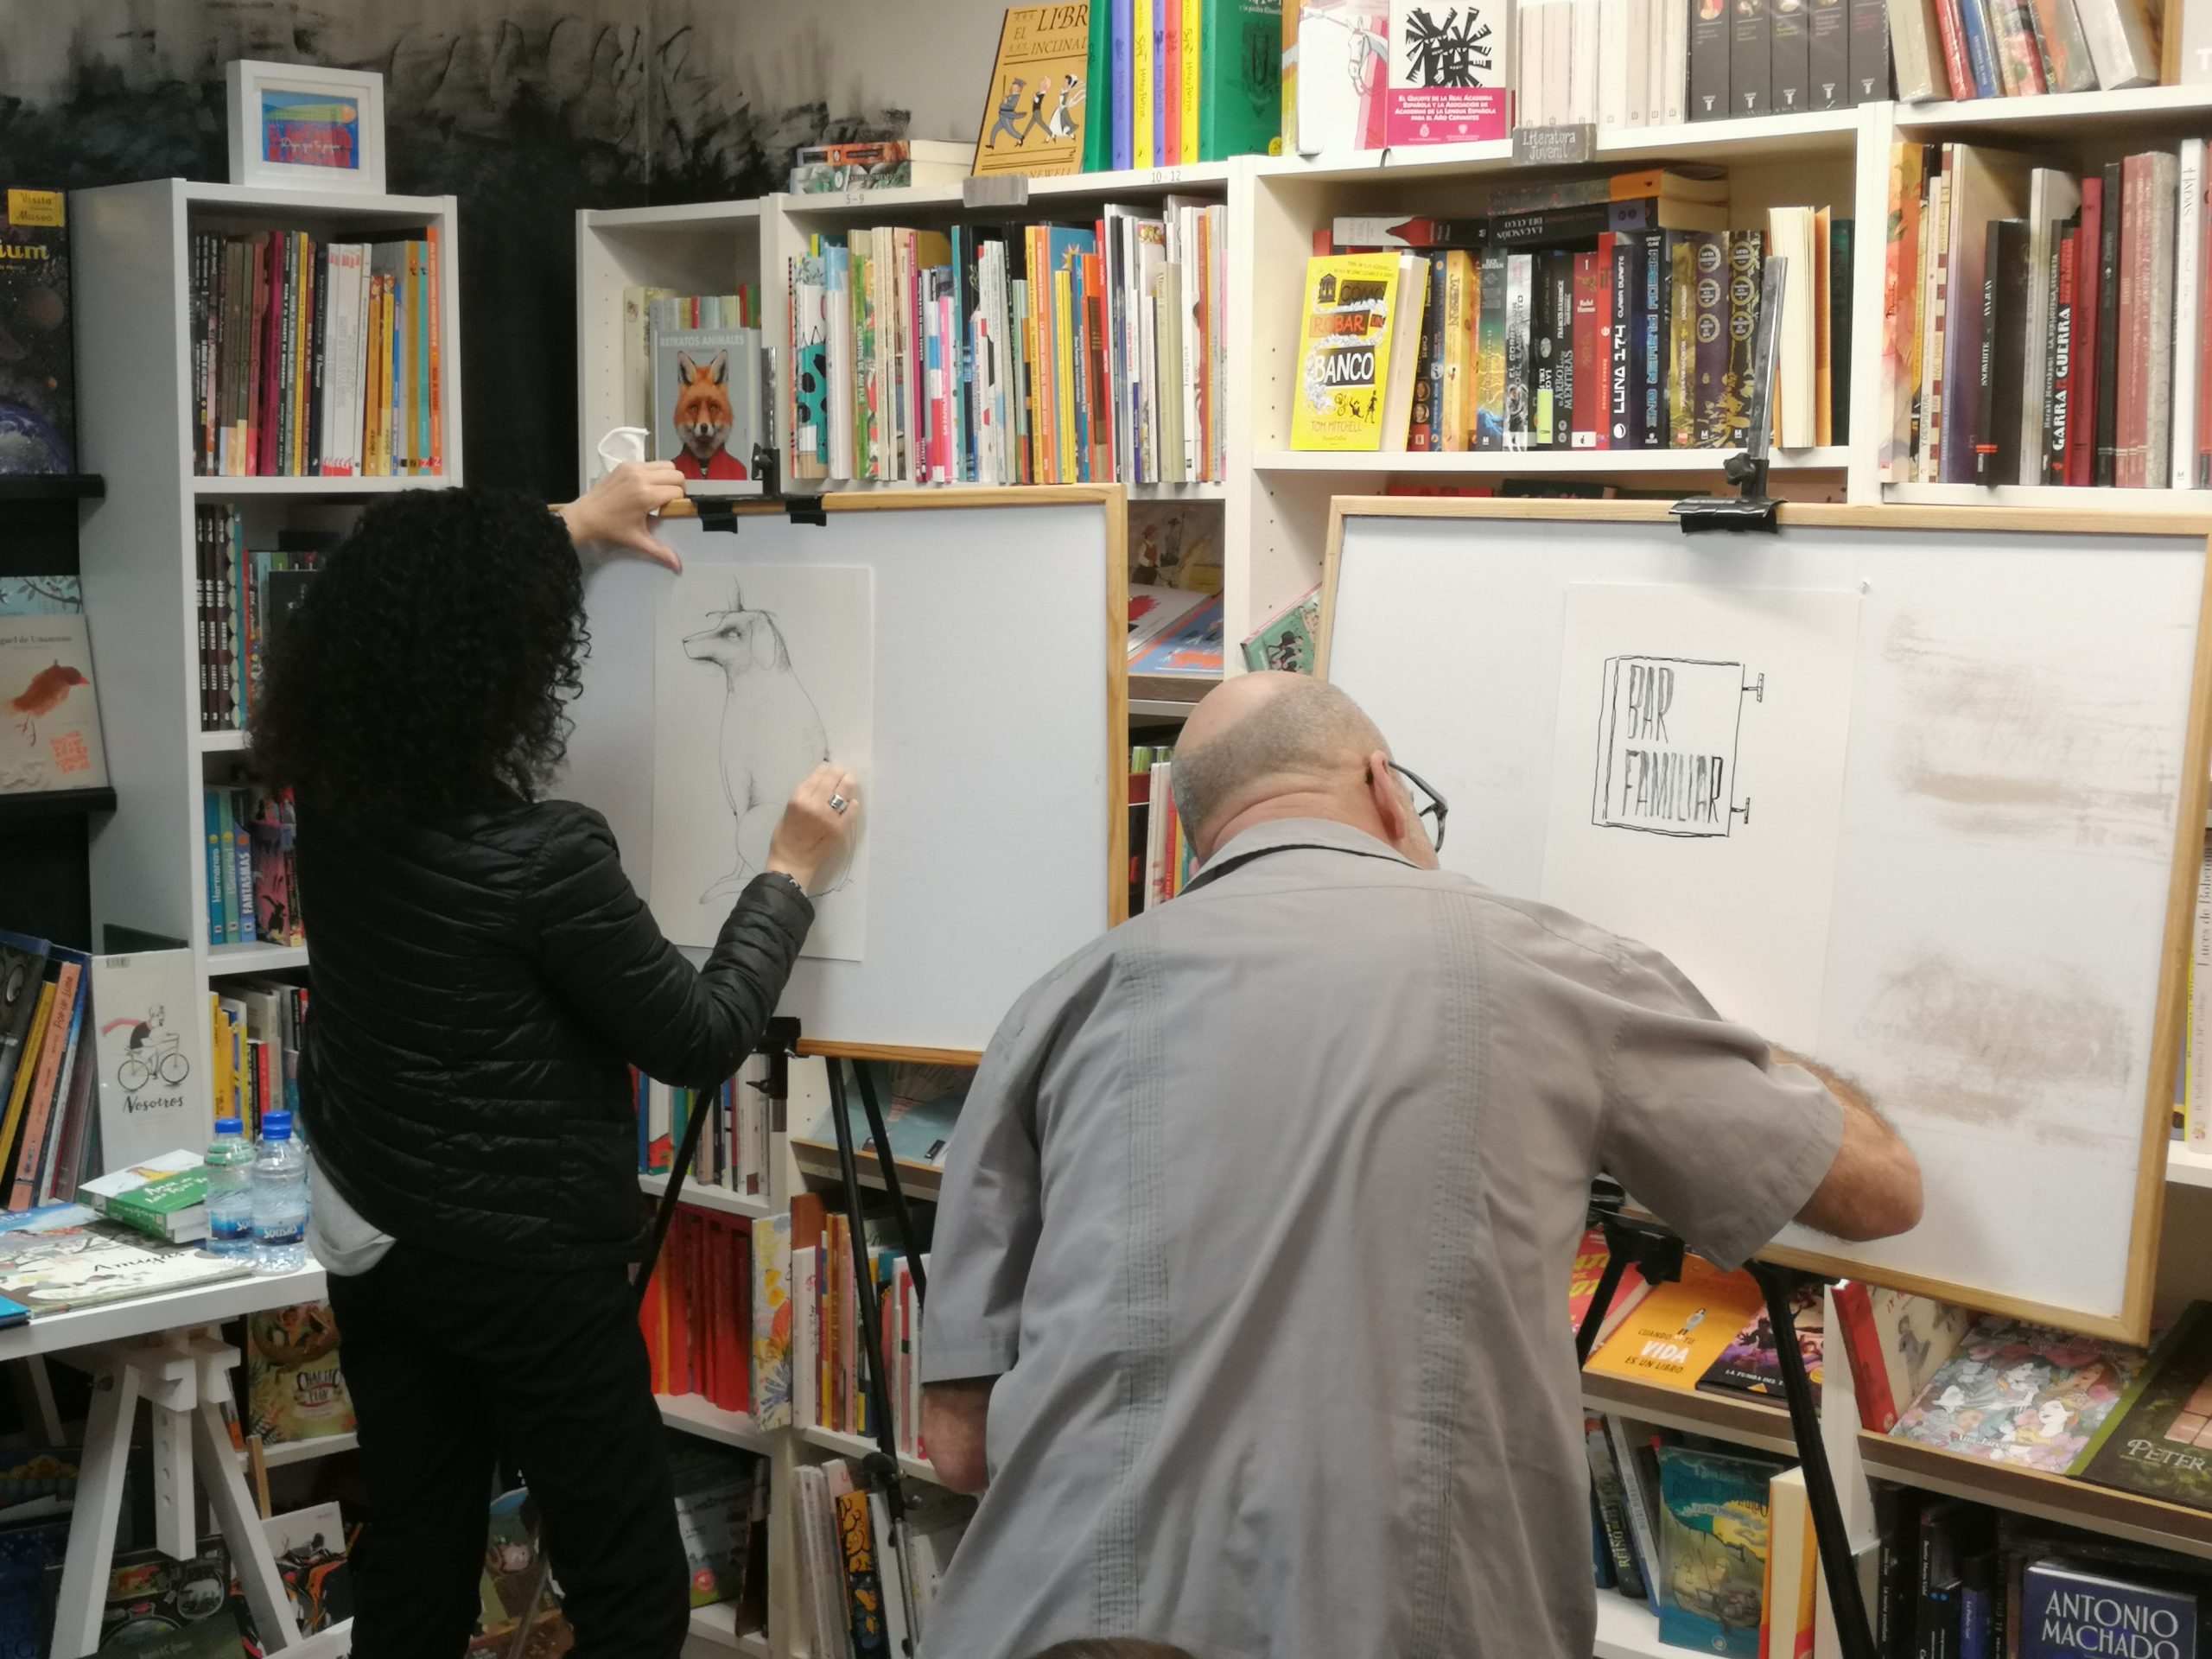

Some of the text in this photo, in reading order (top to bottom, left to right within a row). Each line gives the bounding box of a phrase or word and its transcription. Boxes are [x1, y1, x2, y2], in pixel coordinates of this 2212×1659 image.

[1013, 26, 1027, 40] EL
[1522, 131, 1576, 146] Literatura
[1529, 146, 1569, 161] Juvenil
[1151, 171, 1162, 183] 10
[1170, 169, 1182, 181] 12
[1313, 314, 1366, 333] ROBAR
[1646, 248, 1659, 429] READY PLAYER ONE
[660, 334, 745, 346] RETRATOS ANIMALES
[1613, 324, 1627, 363] 174
[2056, 308, 2071, 378] GUERRA
[1313, 353, 1375, 385] BANCO
[1510, 365, 1516, 378] EL
[1563, 349, 1573, 410] MENTIRAS
[1612, 366, 1627, 414] LUNA
[1311, 418, 1363, 432] TOM MITCHELL
[2052, 389, 2068, 451] GARRA
[1627, 664, 1675, 743] BAR
[1622, 748, 1724, 823] FAMILIAR
[212, 848, 222, 903] Hermanos
[238, 852, 253, 914] FANTASMAS
[2198, 912, 2210, 925] de
[2196, 929, 2210, 967] Luces
[123, 1094, 184, 1115] Nosotros
[1638, 1327, 1673, 1341] CUANDO
[1624, 1355, 1685, 1375] ES UN LIBRO
[1640, 1339, 1690, 1364] VIDA
[2126, 1438, 2205, 1471] PETER
[2044, 1590, 2179, 1639] ANTONIO
[2042, 1618, 2180, 1659] MACHADO
